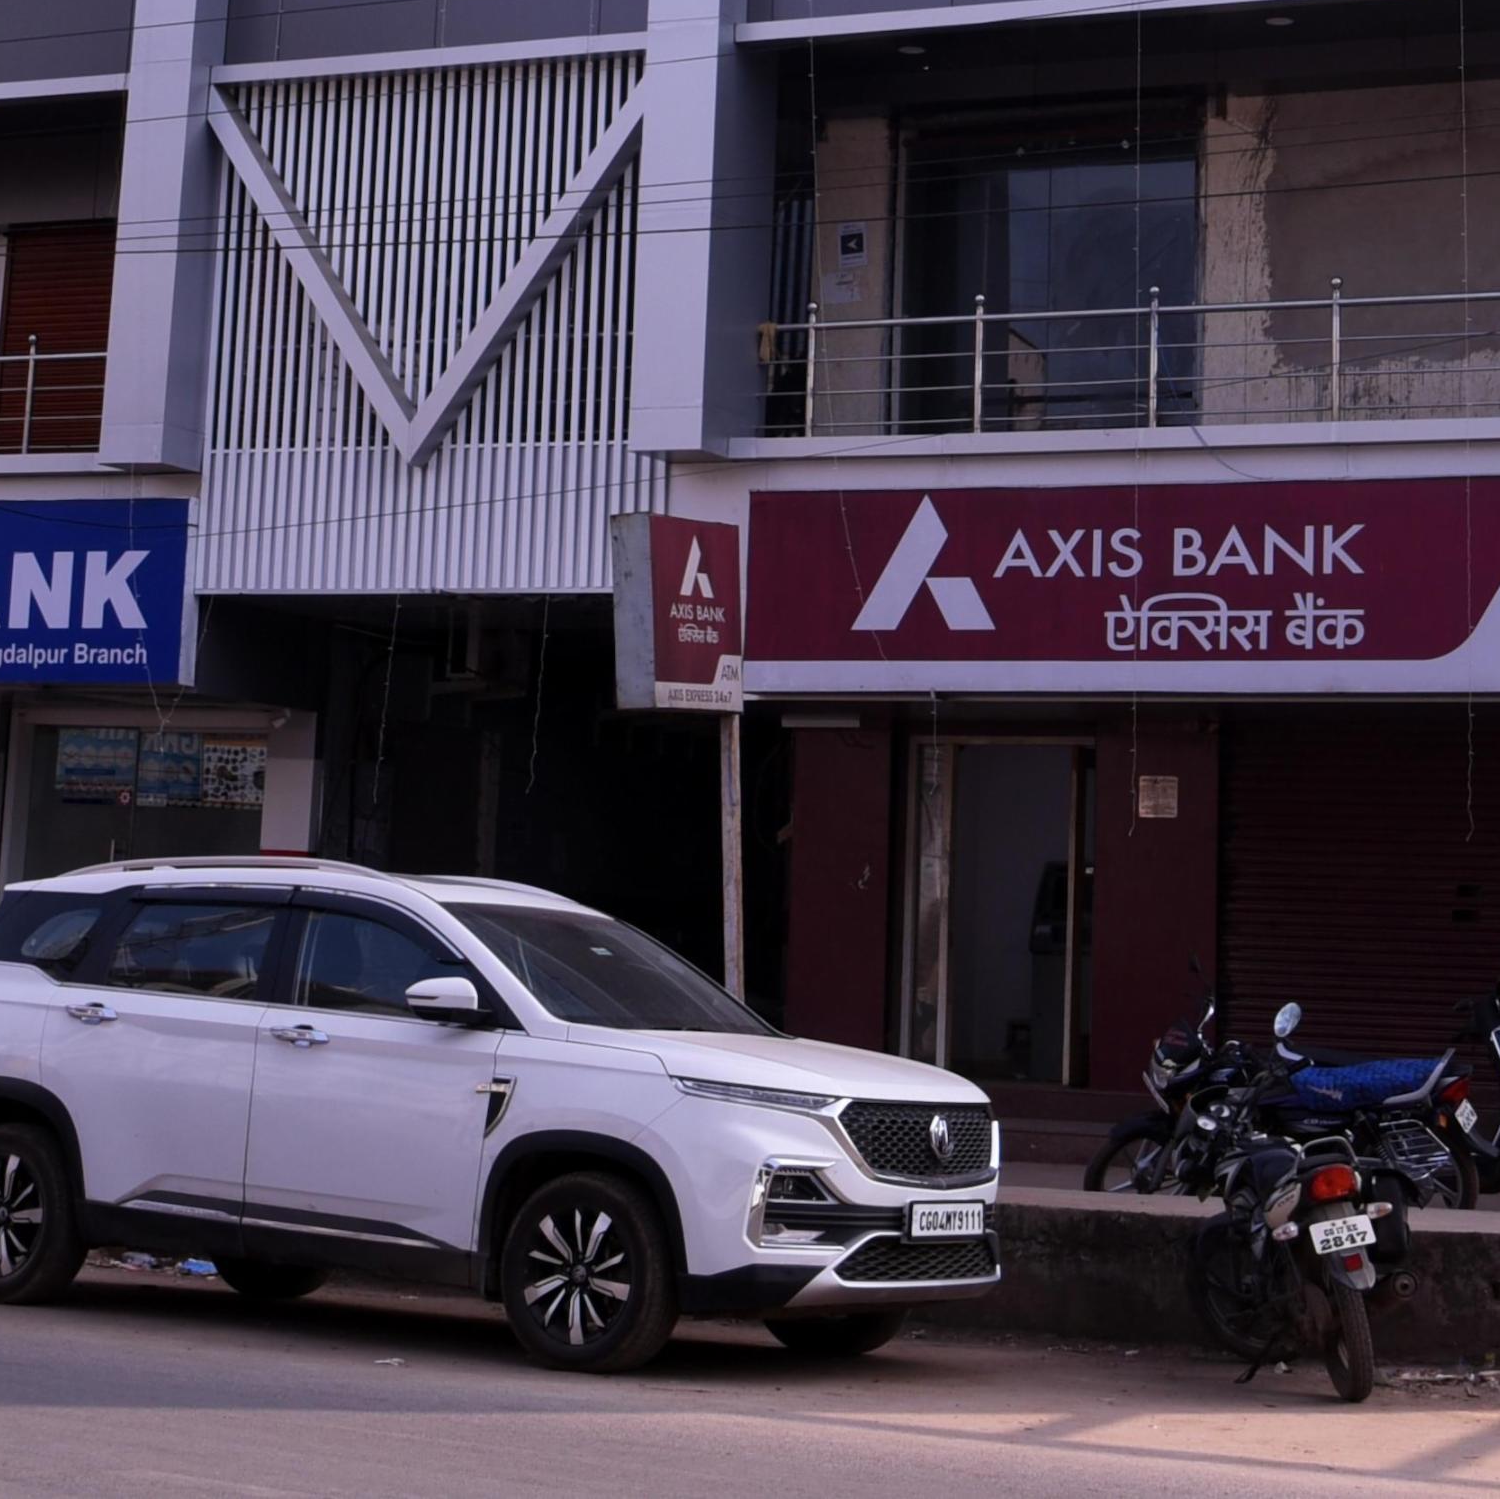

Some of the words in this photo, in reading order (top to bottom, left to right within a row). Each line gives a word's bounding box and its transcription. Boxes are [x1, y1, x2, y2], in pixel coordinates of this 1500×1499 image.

[993, 527, 1144, 578] AXIS
[1172, 524, 1365, 577] BANK
[669, 602, 694, 620] AXIS
[697, 604, 725, 622] BANK
[1104, 592, 1273, 652] ऐक्सिस
[1284, 592, 1365, 650] बैंक
[73, 642, 147, 665] Branch
[720, 664, 739, 681] ATM
[668, 688, 684, 702] AXIS
[685, 689, 713, 703] EXPRESS
[919, 1210, 982, 1232] CG04MY9111
[1320, 1230, 1368, 1251] 2847
